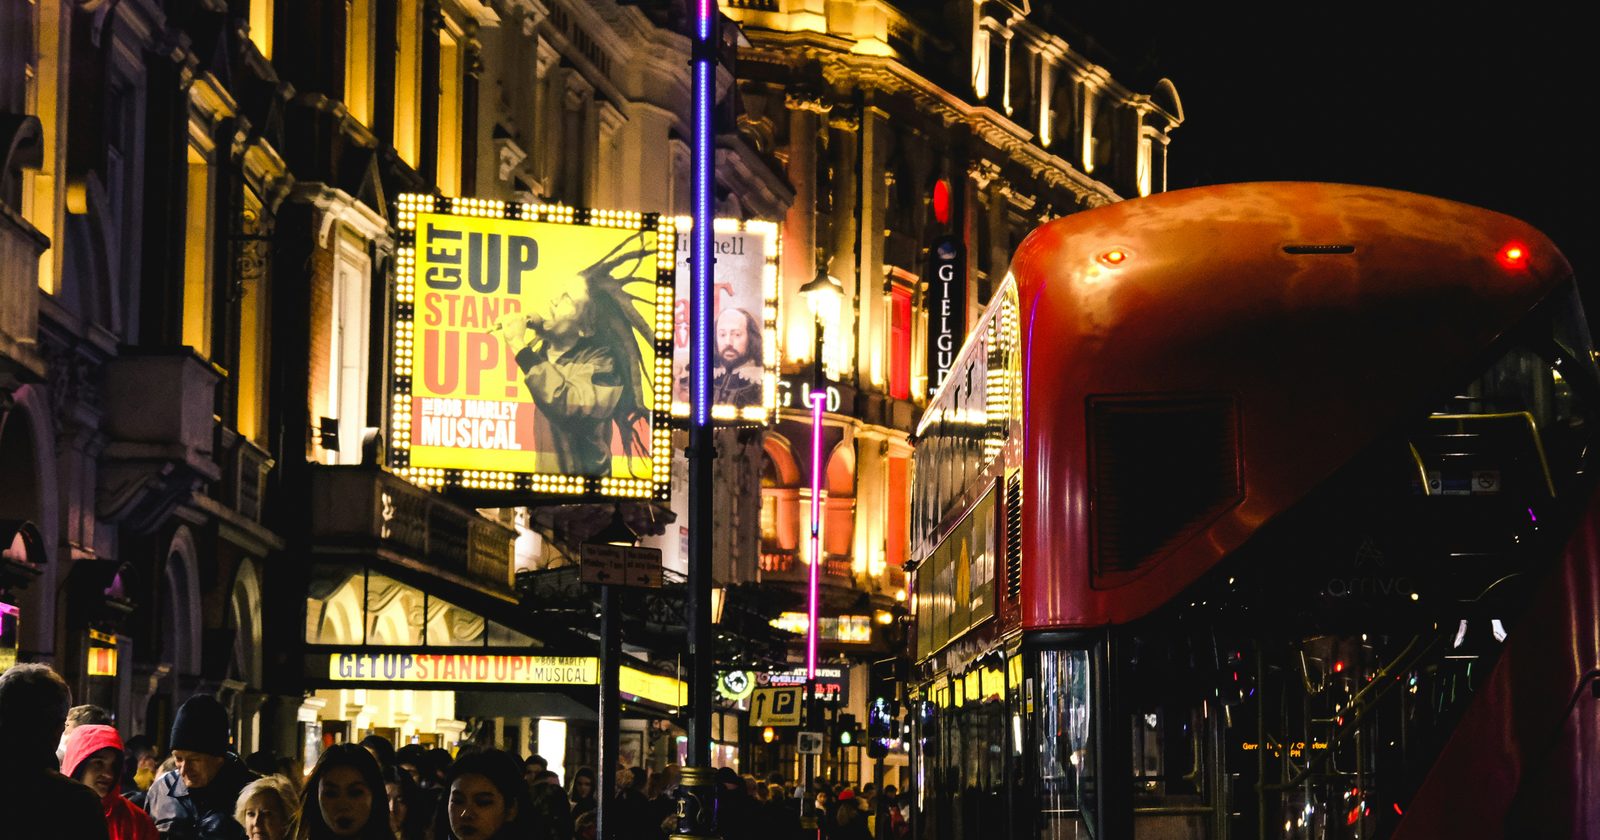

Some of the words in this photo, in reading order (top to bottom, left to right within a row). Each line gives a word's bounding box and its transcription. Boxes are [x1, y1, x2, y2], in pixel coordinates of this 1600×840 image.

[425, 223, 462, 290] GET
[468, 232, 539, 295] UP
[424, 329, 518, 397] UP!
[434, 398, 462, 418] BOB
[464, 401, 518, 420] MARLEY
[420, 416, 522, 450] MUSICAL
[339, 653, 380, 679] GET
[382, 654, 413, 680] UP
[415, 655, 489, 681] STAND
[495, 655, 532, 681] UP!
[535, 667, 588, 682] MUSICAL
[777, 693, 791, 712] P
